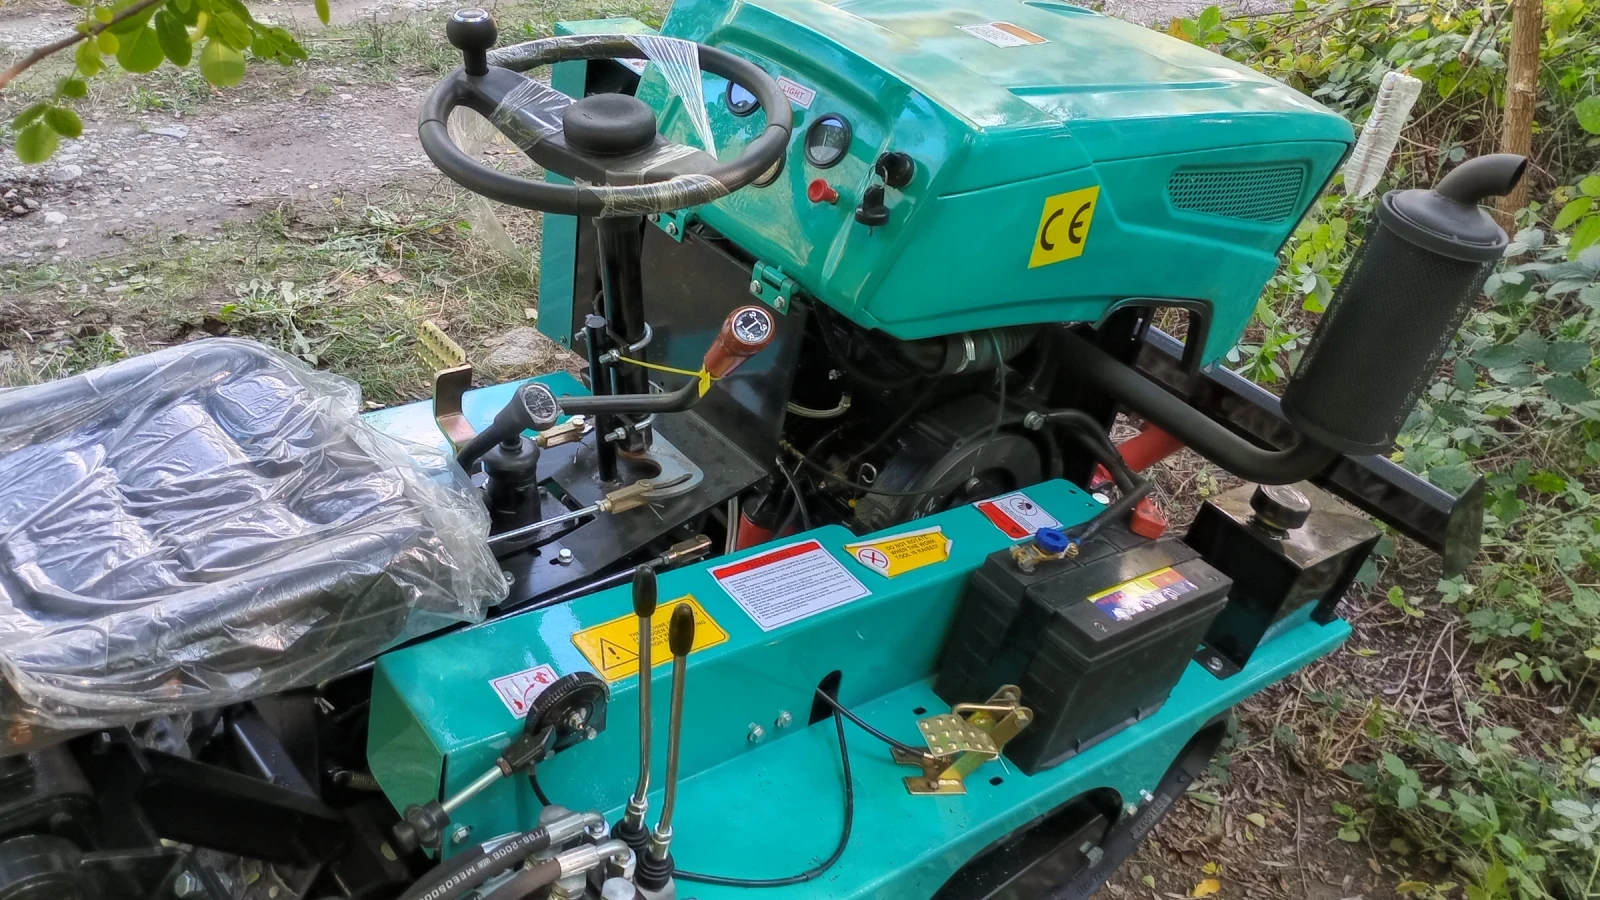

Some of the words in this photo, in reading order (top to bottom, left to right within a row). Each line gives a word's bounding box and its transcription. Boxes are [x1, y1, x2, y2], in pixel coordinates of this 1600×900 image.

[783, 85, 805, 99] LIGHT
[1040, 201, 1092, 251] CE
[920, 539, 936, 547] WORK
[744, 551, 790, 569] PRECAUTIONS
